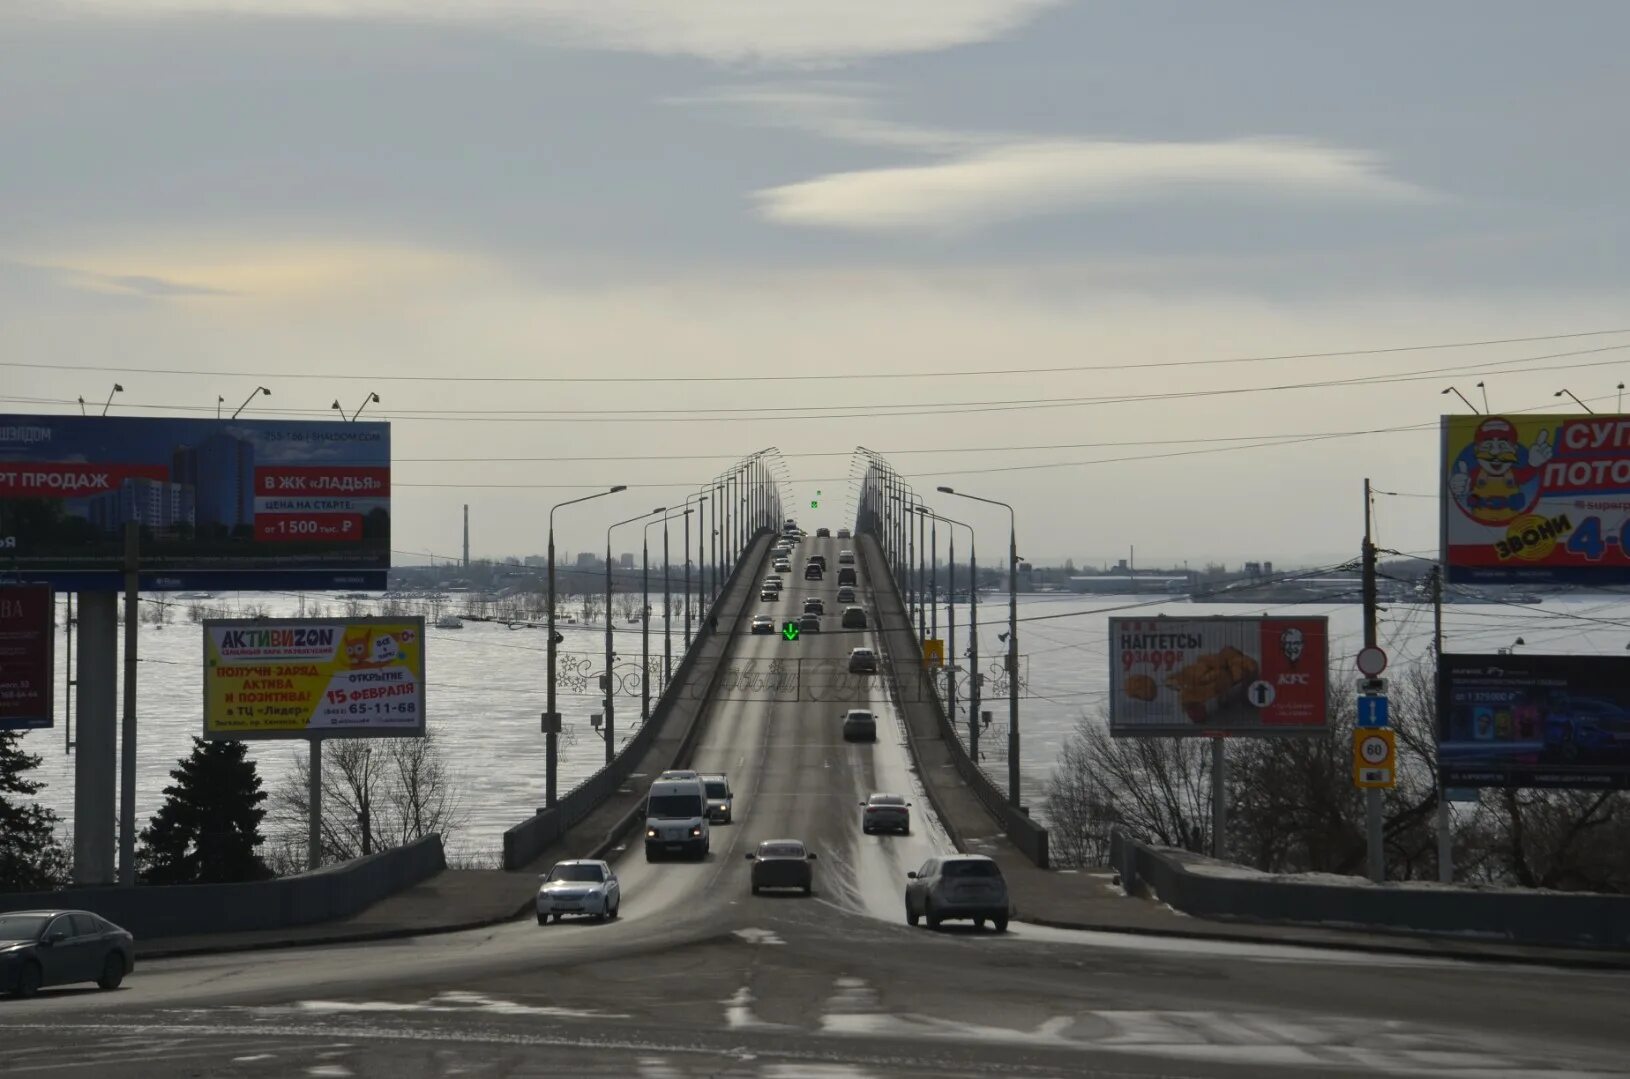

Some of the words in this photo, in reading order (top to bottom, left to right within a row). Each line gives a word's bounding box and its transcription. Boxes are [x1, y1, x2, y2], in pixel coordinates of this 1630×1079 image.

[22, 471, 109, 490] ПРОДАЖ
[264, 476, 275, 489] В
[279, 476, 306, 489] ЖК
[265, 501, 293, 511] ЦЕНА
[297, 501, 311, 510] НА
[289, 520, 318, 533] 500
[1496, 514, 1572, 558] ЗВОНИ
[1121, 633, 1203, 649] НАГГЕТСЫ
[276, 665, 320, 676] ЗАРЯД
[348, 671, 404, 683] ОТКРЫТИЕ
[243, 680, 294, 690] АКТИВА
[327, 689, 347, 705] 15
[350, 682, 415, 701] ФЕВРАЛЯ
[349, 702, 416, 714] 65-11-68
[1367, 744, 1382, 756] 60
